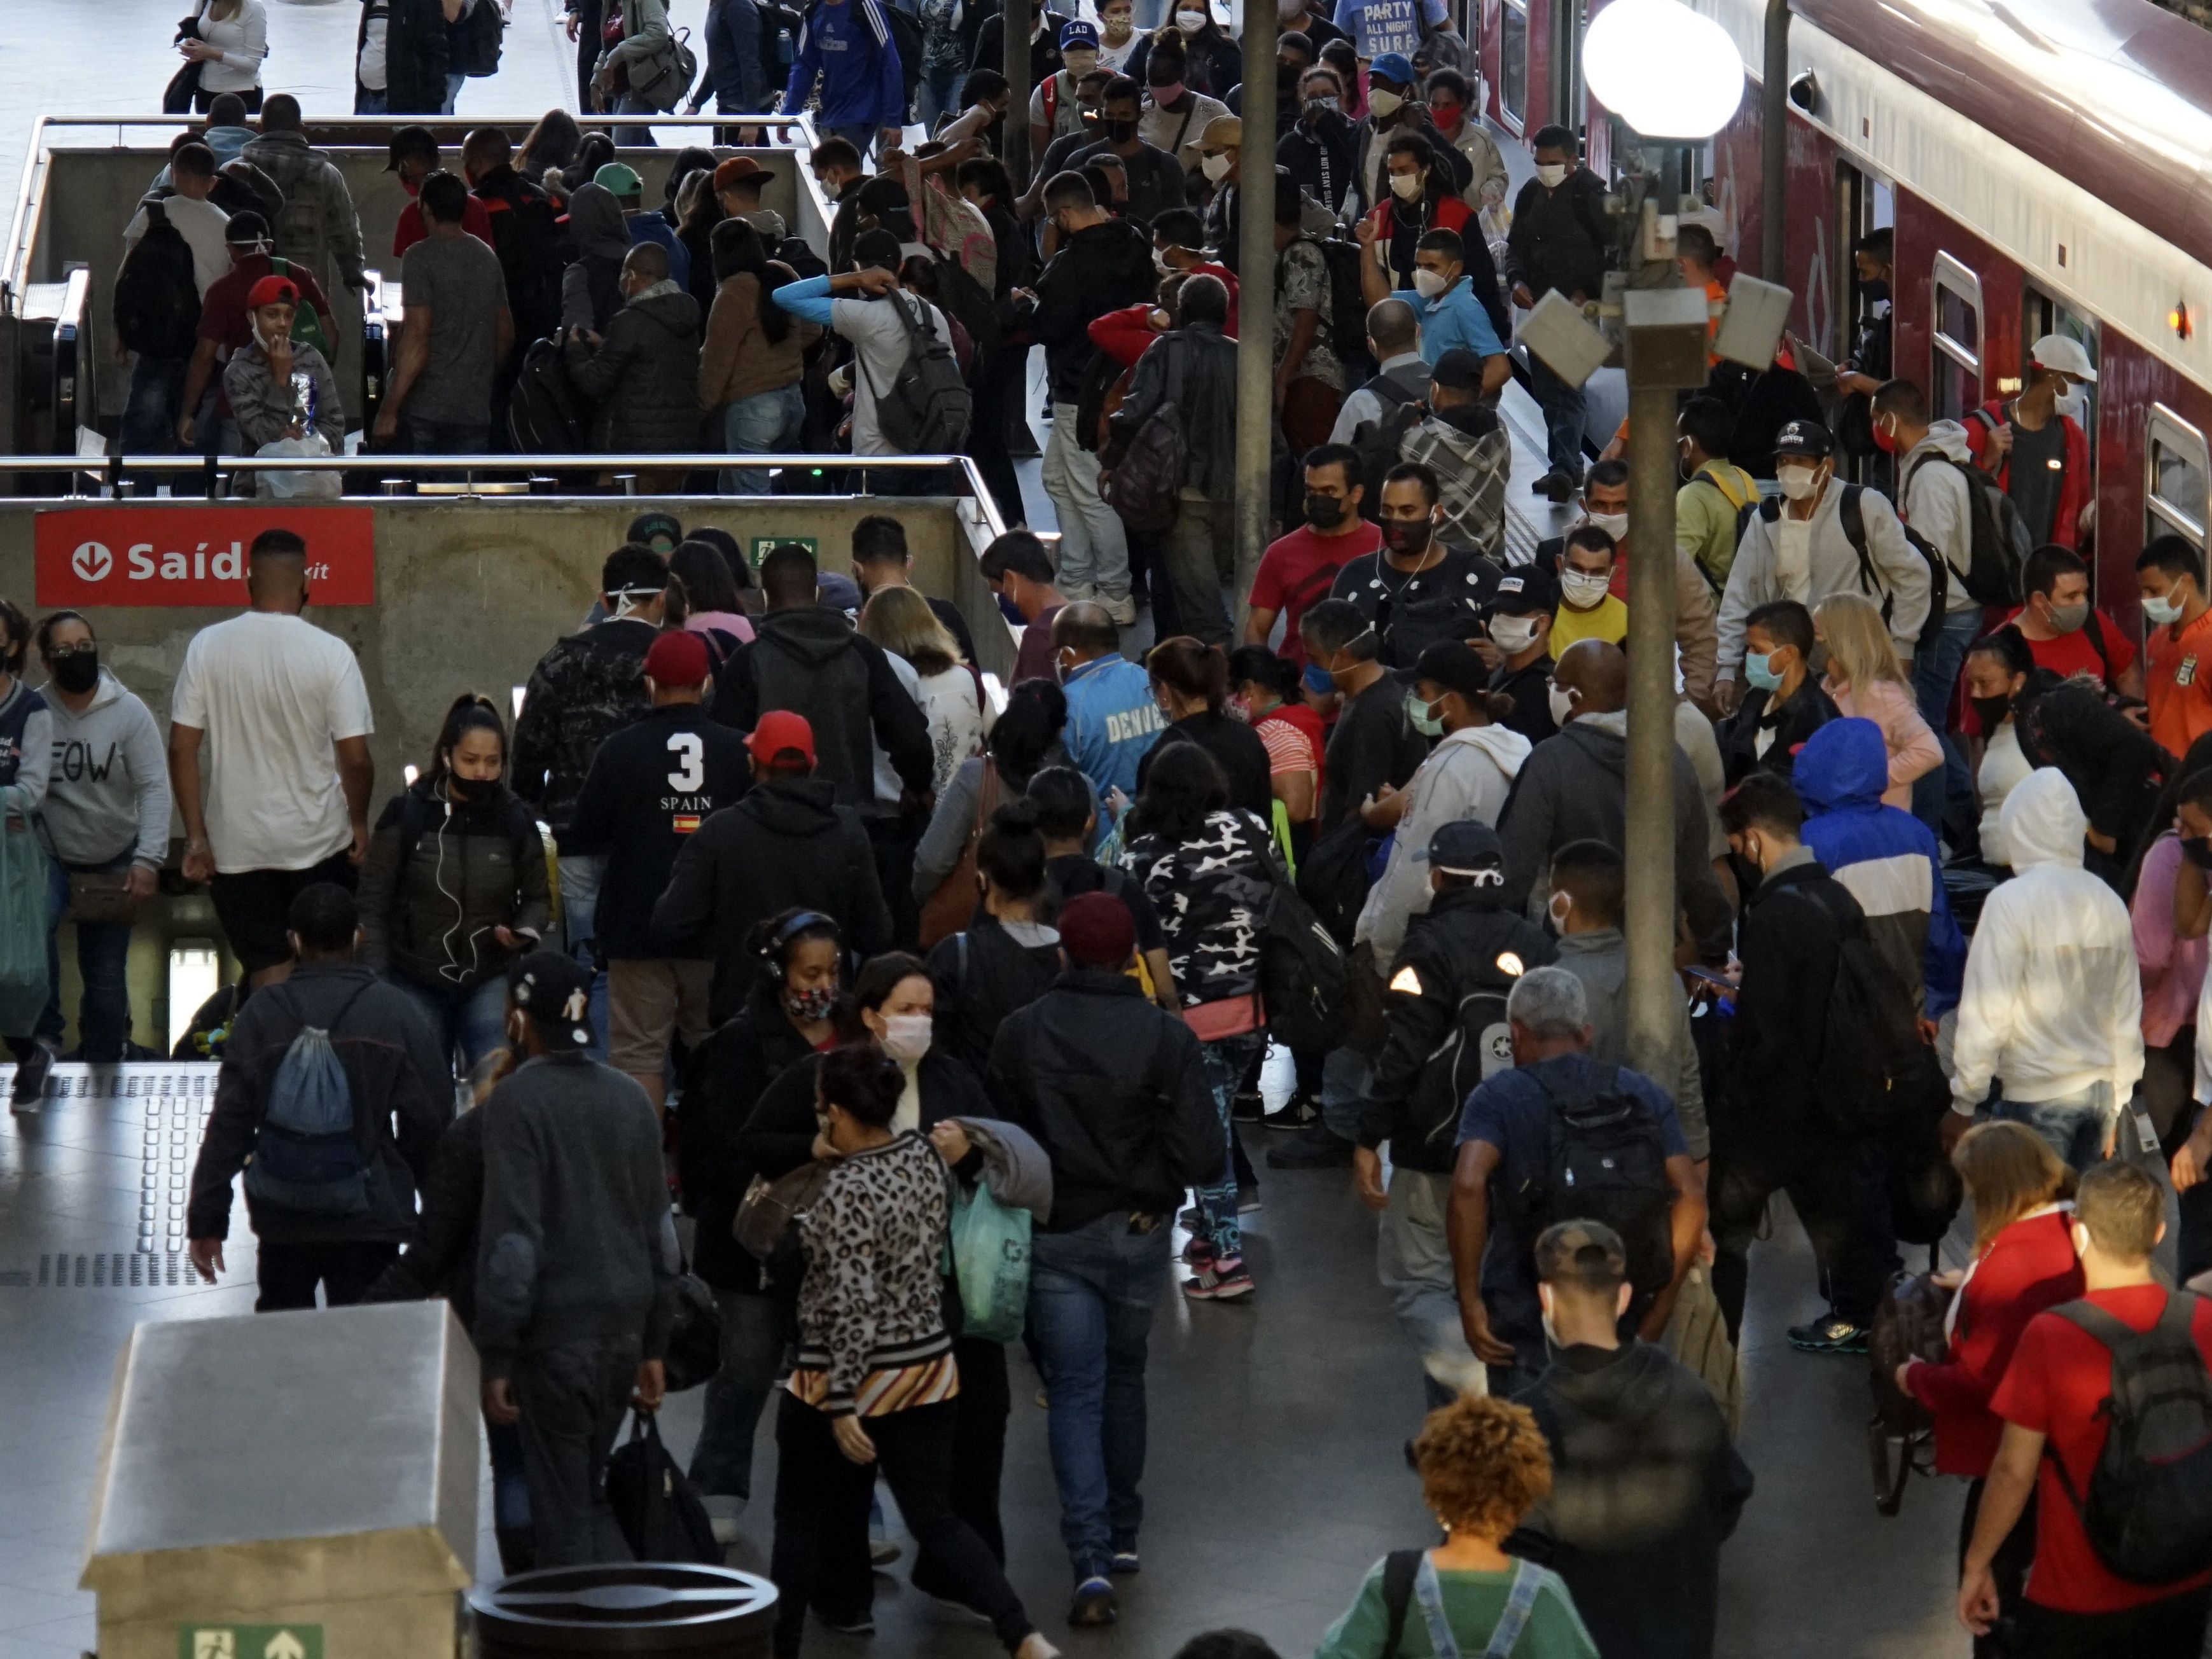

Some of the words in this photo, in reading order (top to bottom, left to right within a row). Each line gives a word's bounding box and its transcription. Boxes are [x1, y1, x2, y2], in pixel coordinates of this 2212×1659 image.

[1364, 1, 1412, 22] PARTY
[1069, 25, 1088, 35] LAD
[1366, 24, 1383, 34] ALL
[1386, 20, 1412, 34] NIGHT
[1368, 34, 1414, 53] SURF
[1320, 156, 1330, 170] NOT
[1321, 170, 1331, 188] STAY
[127, 541, 252, 580] Saíd
[667, 733, 704, 792] 3
[660, 796, 712, 811] SPAIN
